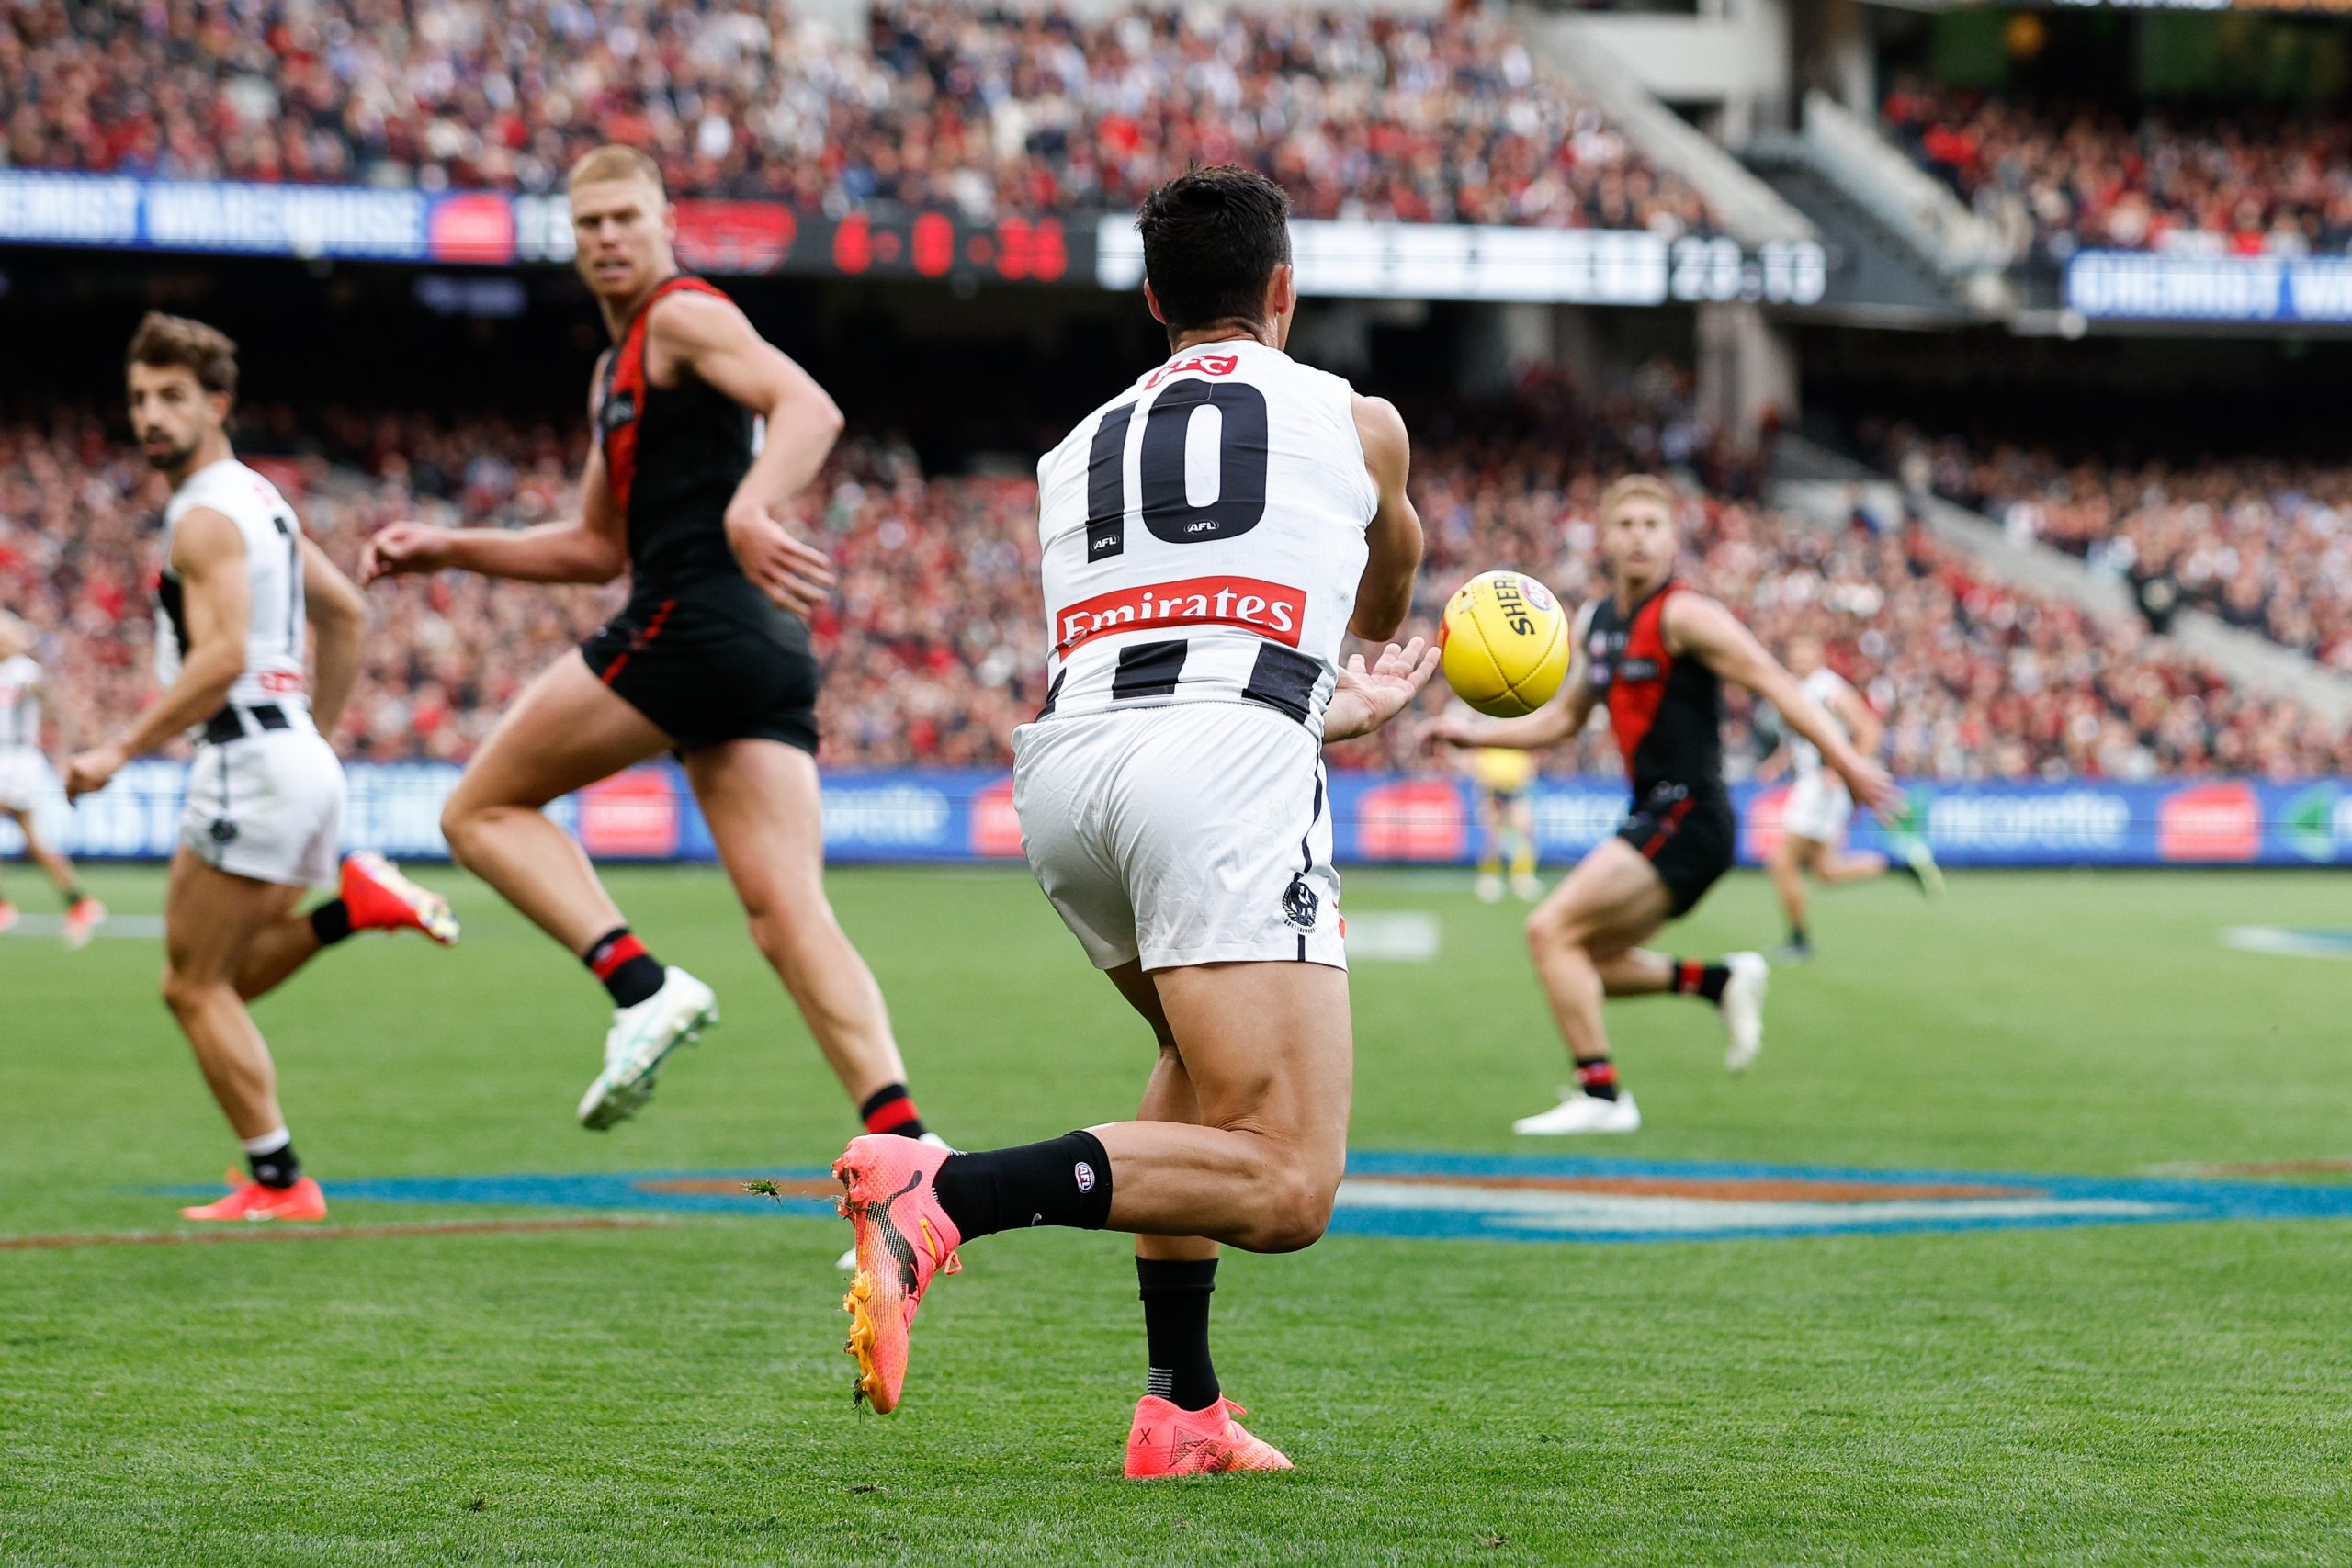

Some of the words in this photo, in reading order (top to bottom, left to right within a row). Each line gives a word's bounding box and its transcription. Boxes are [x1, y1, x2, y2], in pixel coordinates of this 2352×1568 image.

[1087, 378, 1269, 564] 10
[1187, 521, 1216, 533] AFL
[1093, 536, 1117, 550] AFL
[1062, 585, 1294, 647] Emirates
[1078, 1165, 1091, 1191] AFL
